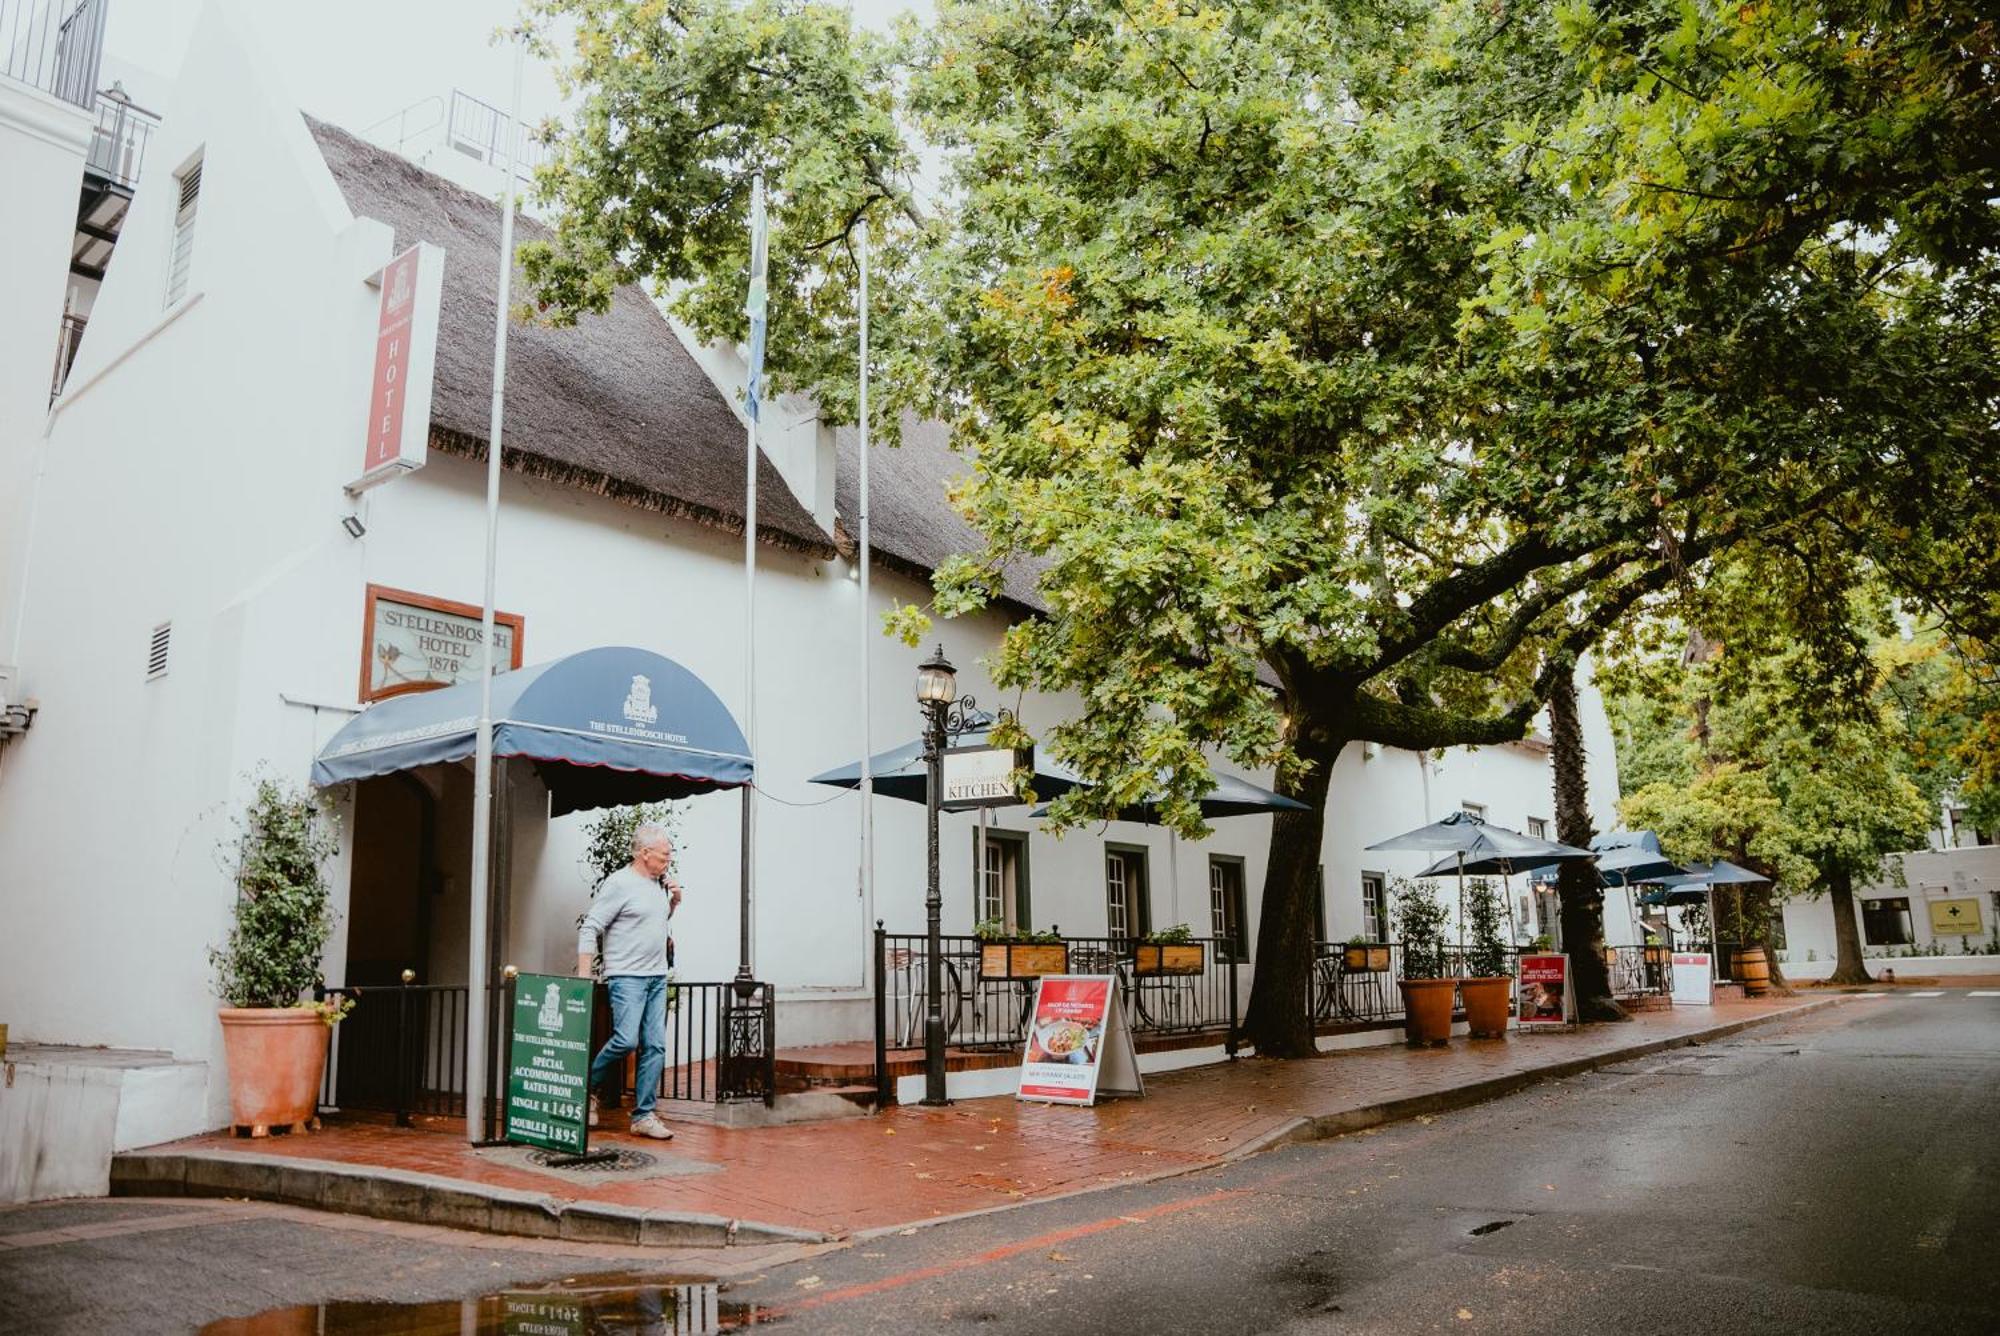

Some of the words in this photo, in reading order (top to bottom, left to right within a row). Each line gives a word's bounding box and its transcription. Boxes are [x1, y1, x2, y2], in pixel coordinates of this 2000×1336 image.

[380, 338, 399, 459] HOTEL
[418, 635, 471, 658] HOTEL
[428, 656, 459, 673] 1876
[589, 720, 605, 731] THE
[606, 723, 665, 740] STELLENBOSCH
[666, 731, 689, 744] HOTEL
[949, 782, 1009, 798] KITCHEN
[532, 1055, 564, 1071] SPECIAL
[514, 1066, 583, 1087] ACCOMMODATION
[523, 1080, 548, 1094] RATES
[549, 1084, 572, 1098] FROM
[511, 1096, 540, 1111] SINGLE
[551, 1101, 582, 1121] 1495
[549, 1125, 577, 1144] 1895
